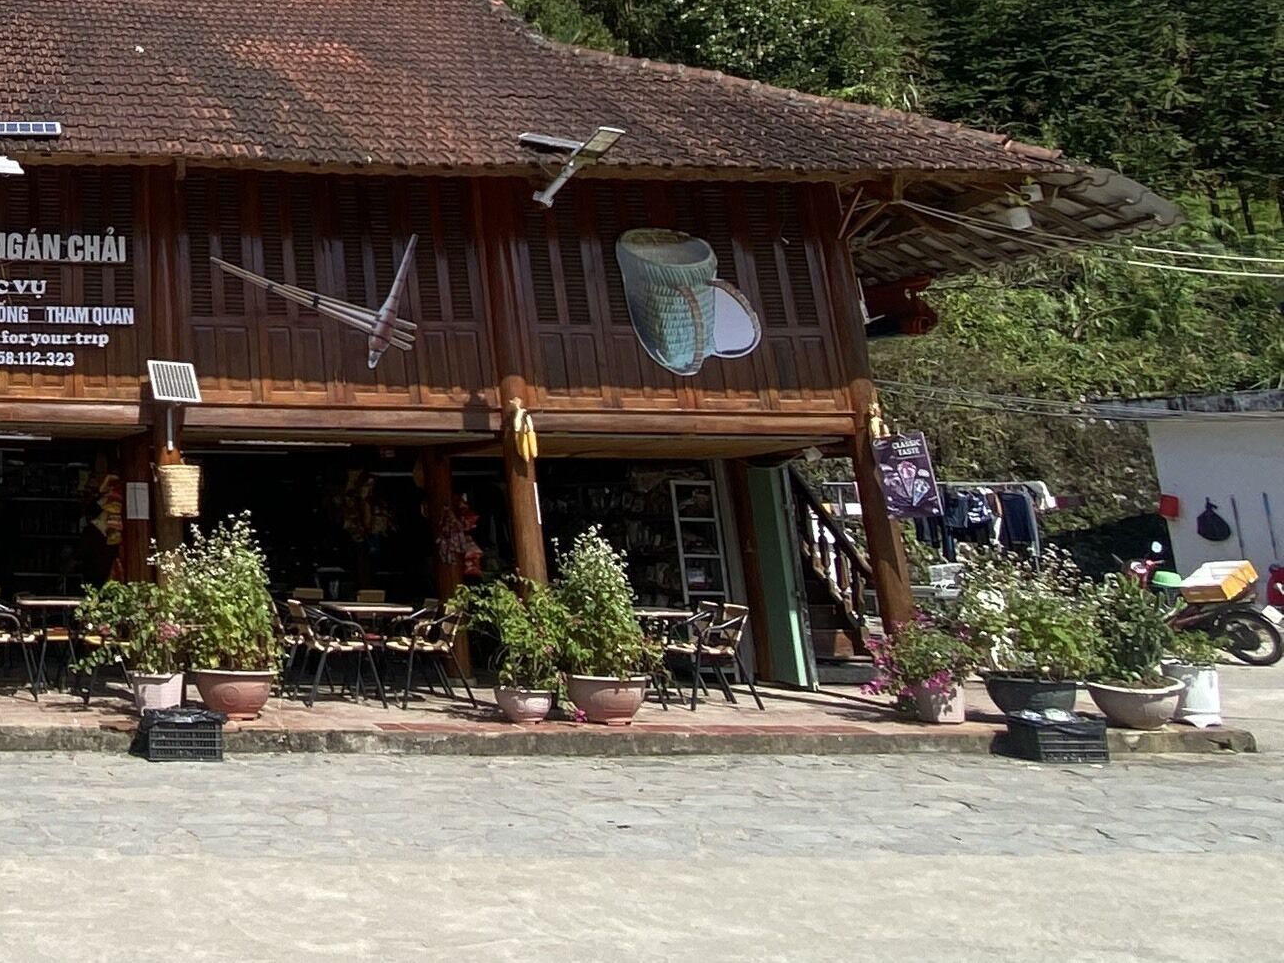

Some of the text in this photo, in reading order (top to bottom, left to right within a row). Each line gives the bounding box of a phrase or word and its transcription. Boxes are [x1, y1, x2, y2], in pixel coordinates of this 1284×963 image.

[67, 226, 127, 263] CHẢI
[12, 279, 47, 299] VỤ
[46, 306, 90, 324] THAM
[91, 307, 135, 326] QUAN
[1, 330, 29, 344] for
[30, 332, 71, 347] your
[75, 332, 110, 348] trip
[891, 439, 922, 450] CLASSIC
[897, 447, 920, 457] TASTE
